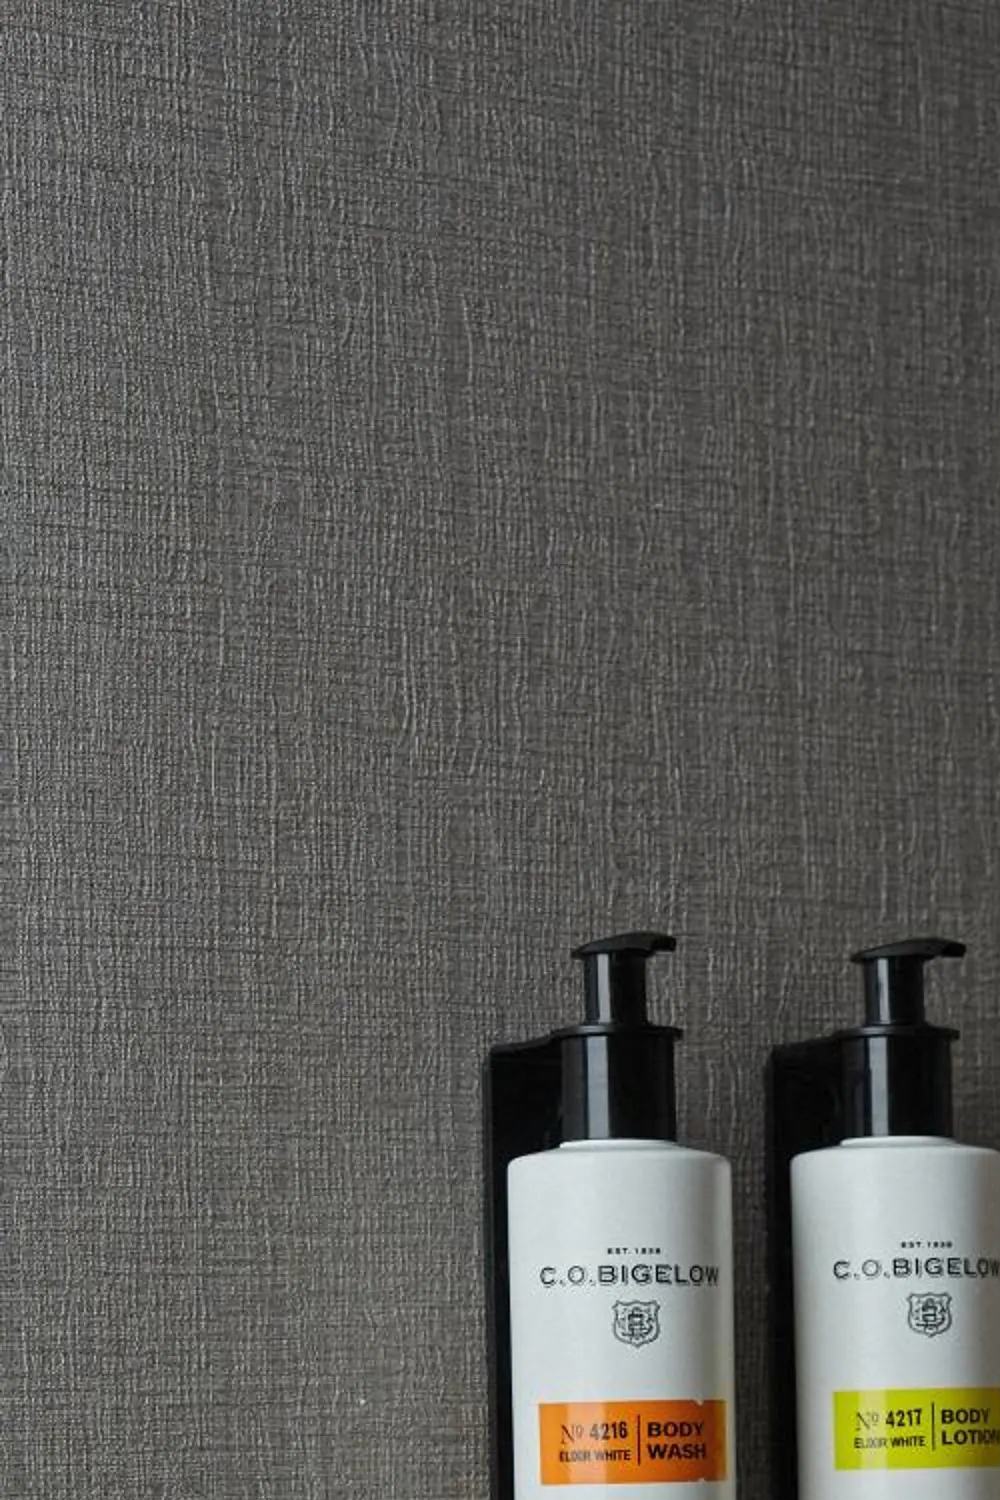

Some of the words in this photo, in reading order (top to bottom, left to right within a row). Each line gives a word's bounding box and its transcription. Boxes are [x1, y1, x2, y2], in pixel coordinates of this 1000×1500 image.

[540, 1264, 719, 1286] C.O.BIGELOW
[885, 1409, 922, 1428] 4217
[941, 1409, 990, 1424] BODY
[590, 1421, 629, 1440] 4216
[648, 1421, 705, 1437] BODY
[941, 1429, 1000, 1445] LOTION
[854, 1436, 887, 1449] ELIXIR
[890, 1435, 926, 1447] WHITE
[559, 1450, 591, 1462] ELIXIR
[594, 1449, 631, 1461] WHITE
[648, 1443, 706, 1460] WASH
